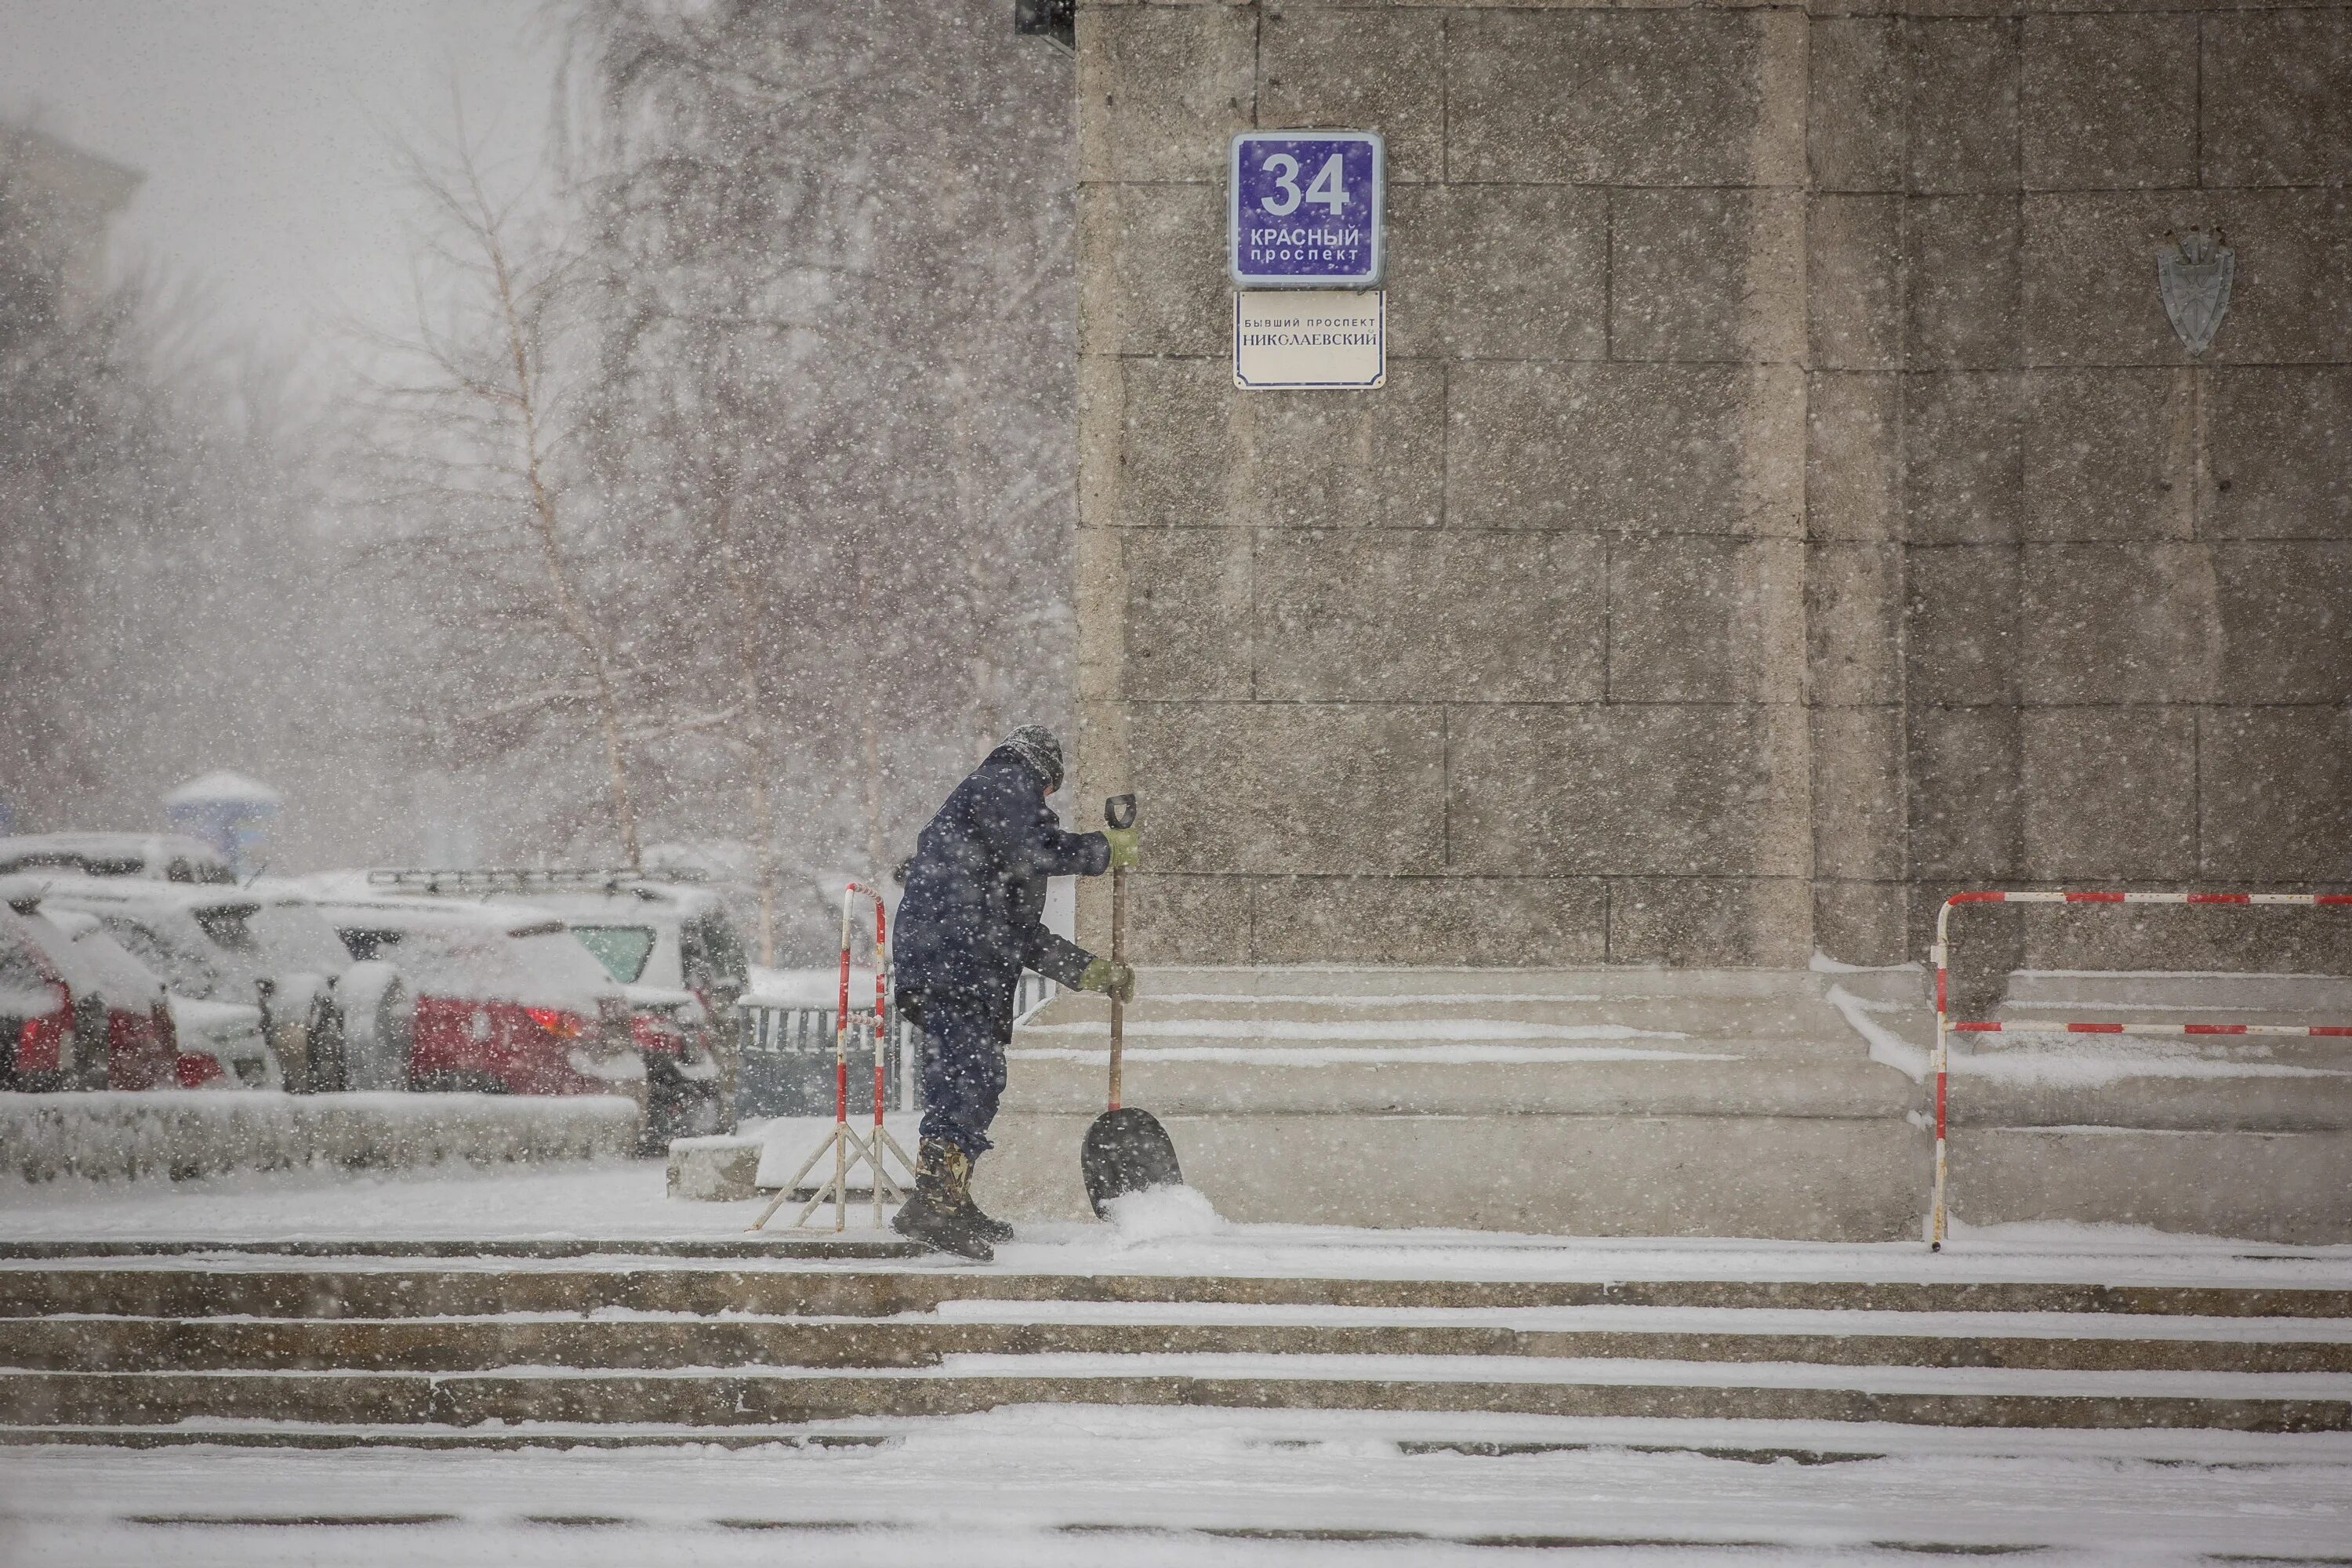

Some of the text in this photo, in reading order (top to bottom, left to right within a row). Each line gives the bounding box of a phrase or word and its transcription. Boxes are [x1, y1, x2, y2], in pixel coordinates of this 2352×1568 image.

[1261, 154, 1350, 216] 34
[1250, 224, 1359, 245] КРАСНЫЙ
[1250, 249, 1359, 263] проспект
[1244, 318, 1376, 328] БЫВШИЙ ПРОСПЕКТ
[1243, 329, 1377, 347] НИКОЛАЕВСКИЙ
